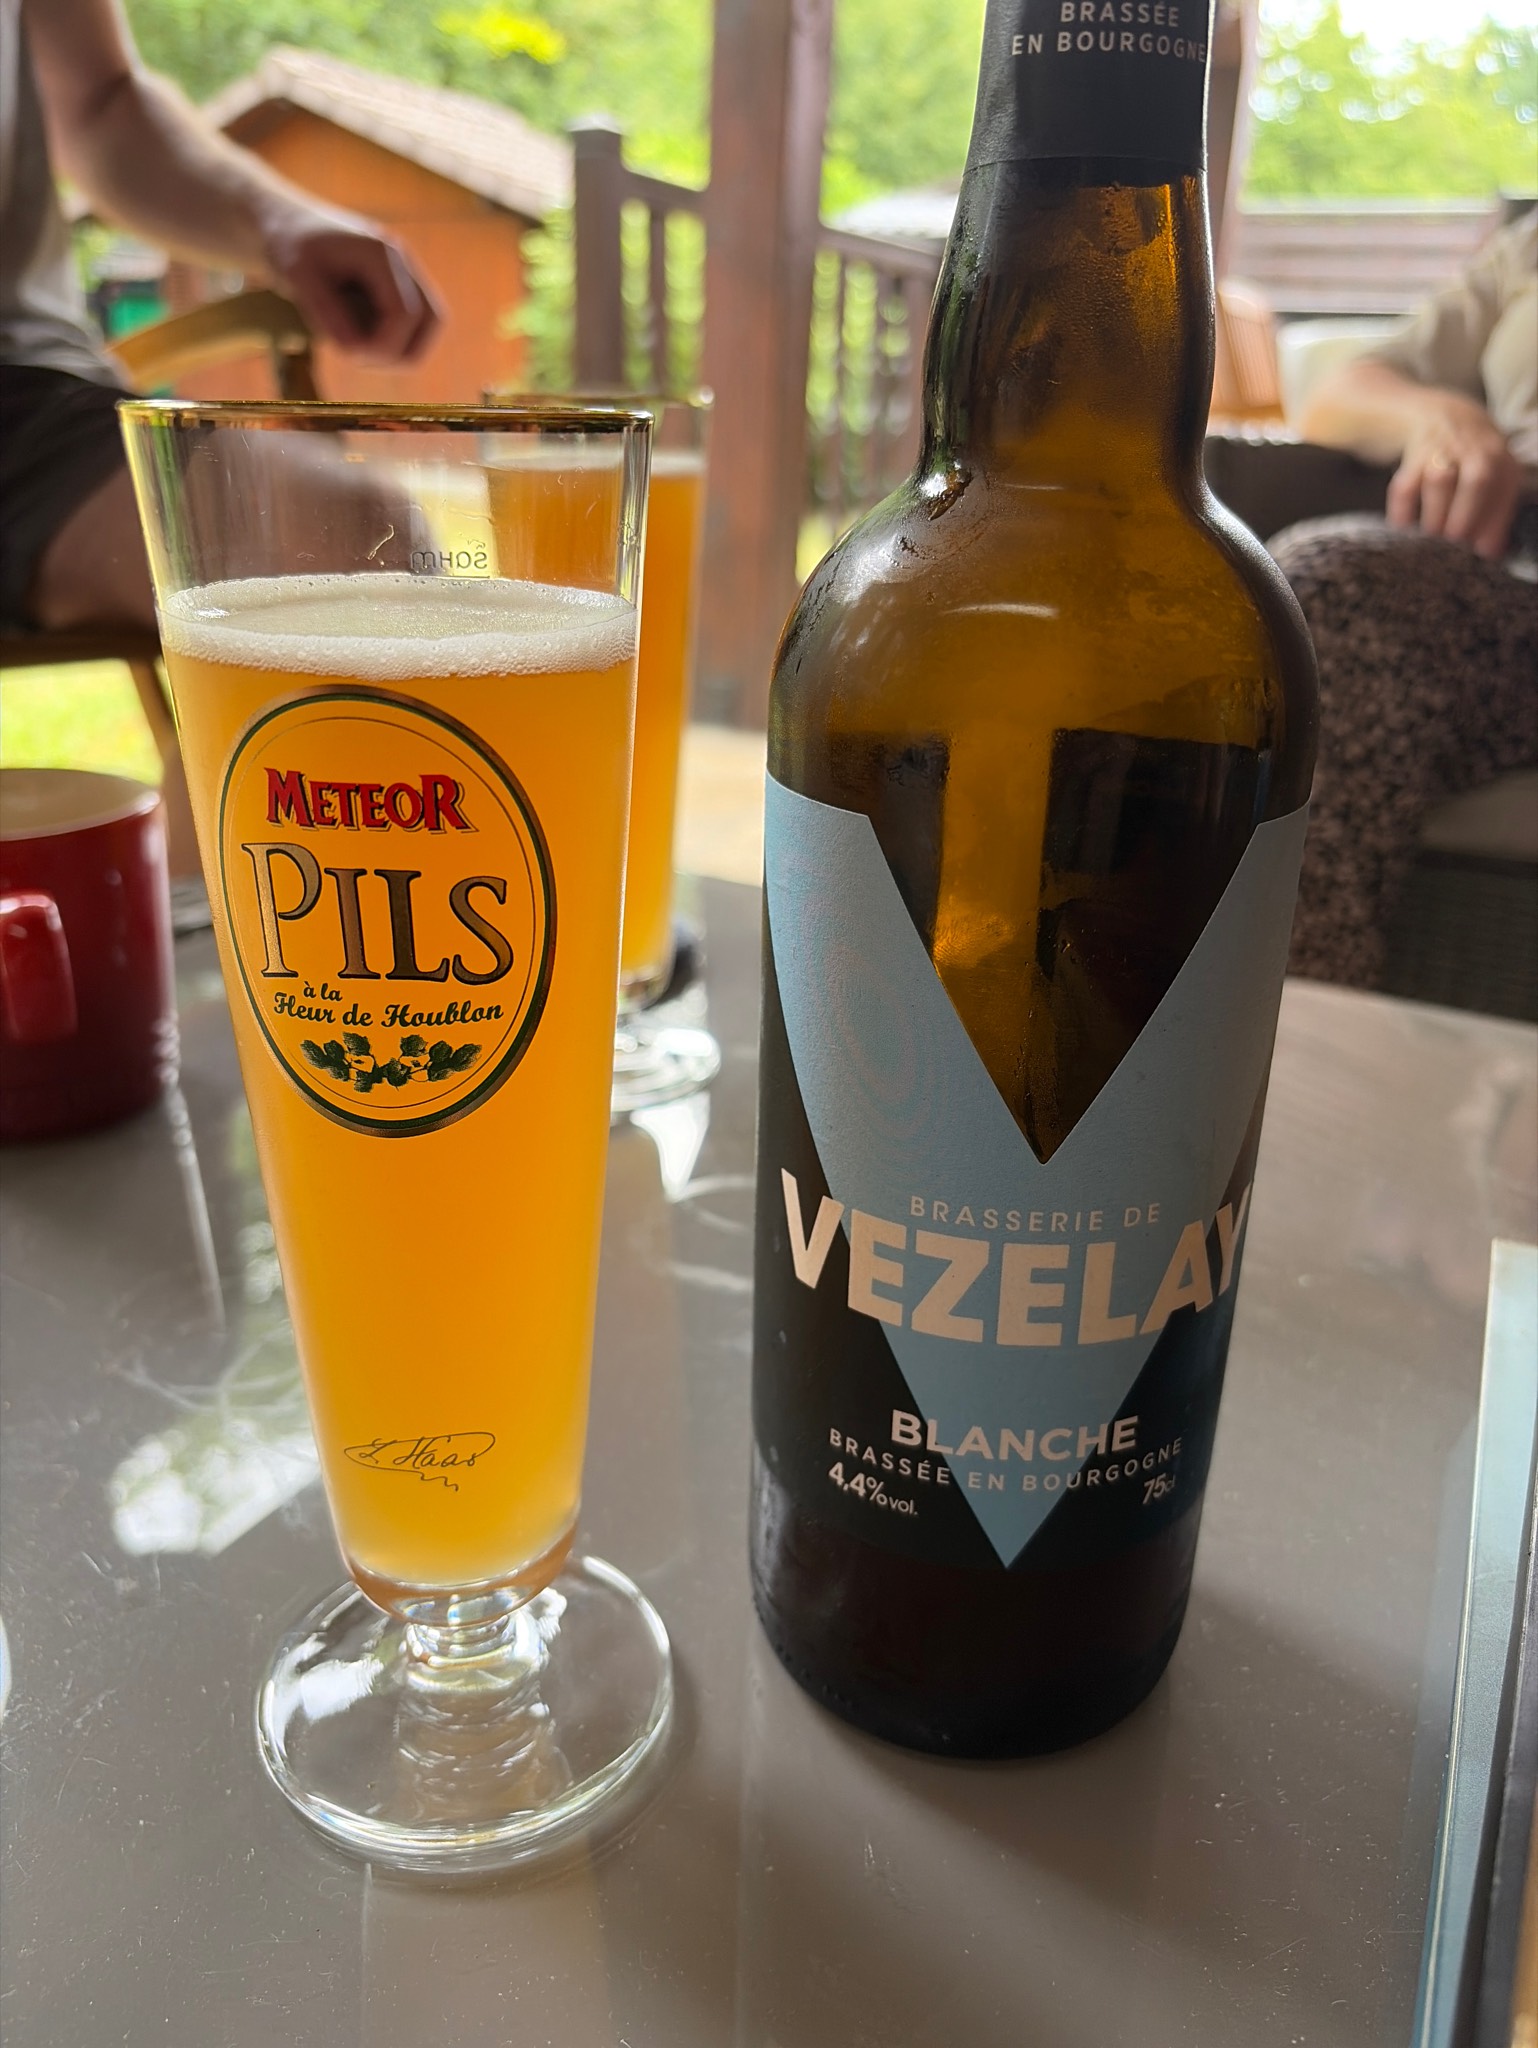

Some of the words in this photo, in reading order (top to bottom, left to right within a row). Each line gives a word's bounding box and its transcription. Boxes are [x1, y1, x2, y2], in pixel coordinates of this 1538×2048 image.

[1060, 1, 1179, 28] BRASSÉE
[1011, 33, 1043, 56] EN
[1057, 31, 1206, 63] BOURGOGNE
[263, 767, 480, 834] METEOR
[241, 842, 515, 986] PILS
[273, 991, 336, 1024] Fleur
[342, 1003, 374, 1027] de
[381, 1000, 505, 1028] Houblon
[303, 981, 316, 999] à
[321, 983, 343, 1002] la
[910, 1195, 1104, 1232] BRASSERIE
[1123, 1203, 1161, 1228] DE
[780, 1168, 1253, 1347] VEZELAY
[891, 1409, 1139, 1461] BLANCHE
[829, 1427, 951, 1485] BRASSÉE
[968, 1472, 1005, 1491] EN
[1022, 1437, 1183, 1492] BOURGOGNE
[1142, 1472, 1177, 1505] 75cl
